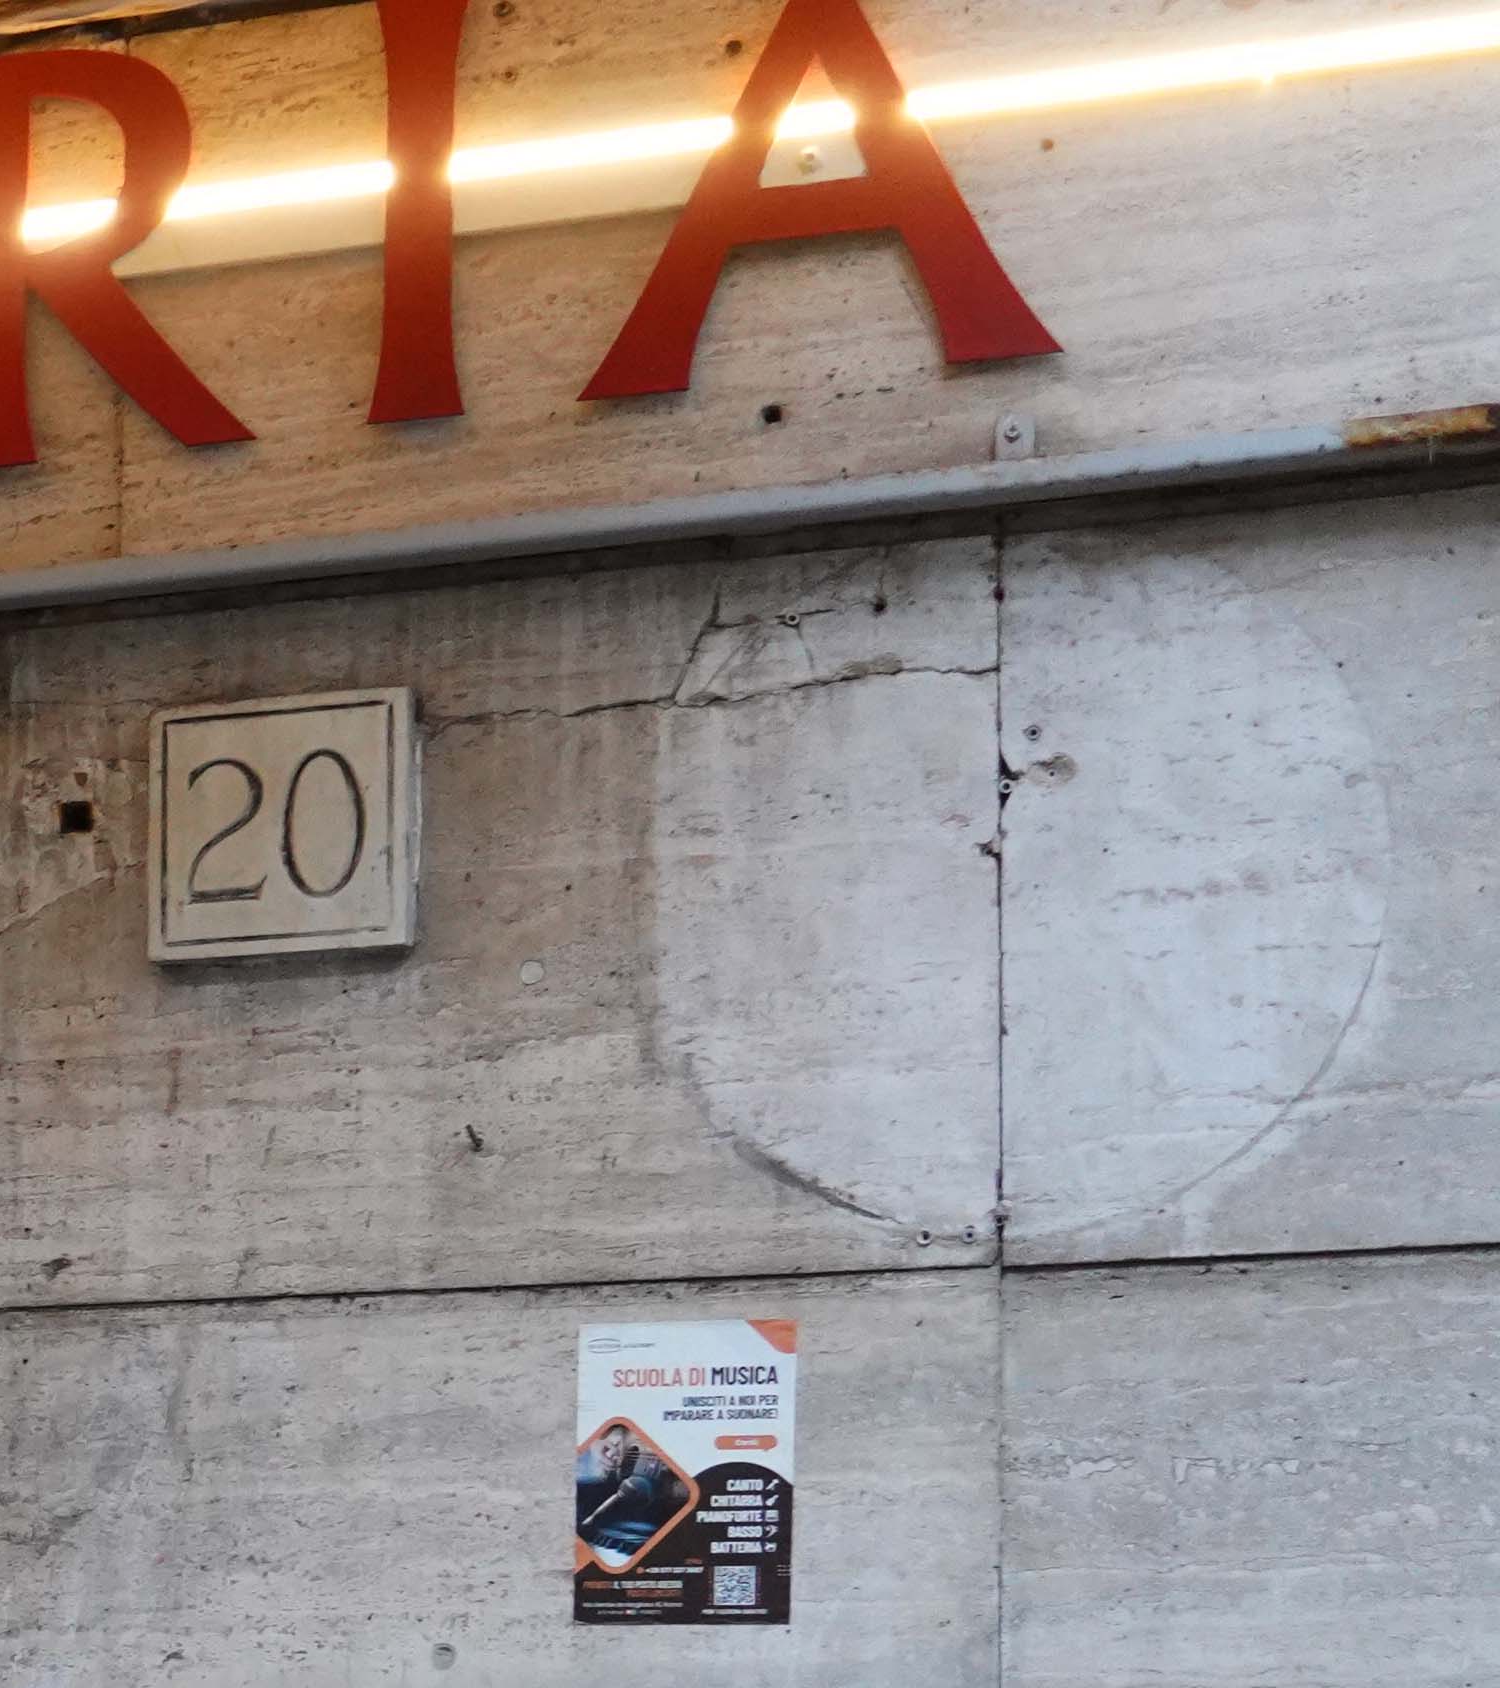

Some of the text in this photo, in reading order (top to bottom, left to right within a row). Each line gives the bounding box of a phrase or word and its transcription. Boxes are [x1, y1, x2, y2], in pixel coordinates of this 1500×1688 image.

[187, 747, 367, 905] 20
[613, 1366, 778, 1388] SCUOLA DI MUSICA
